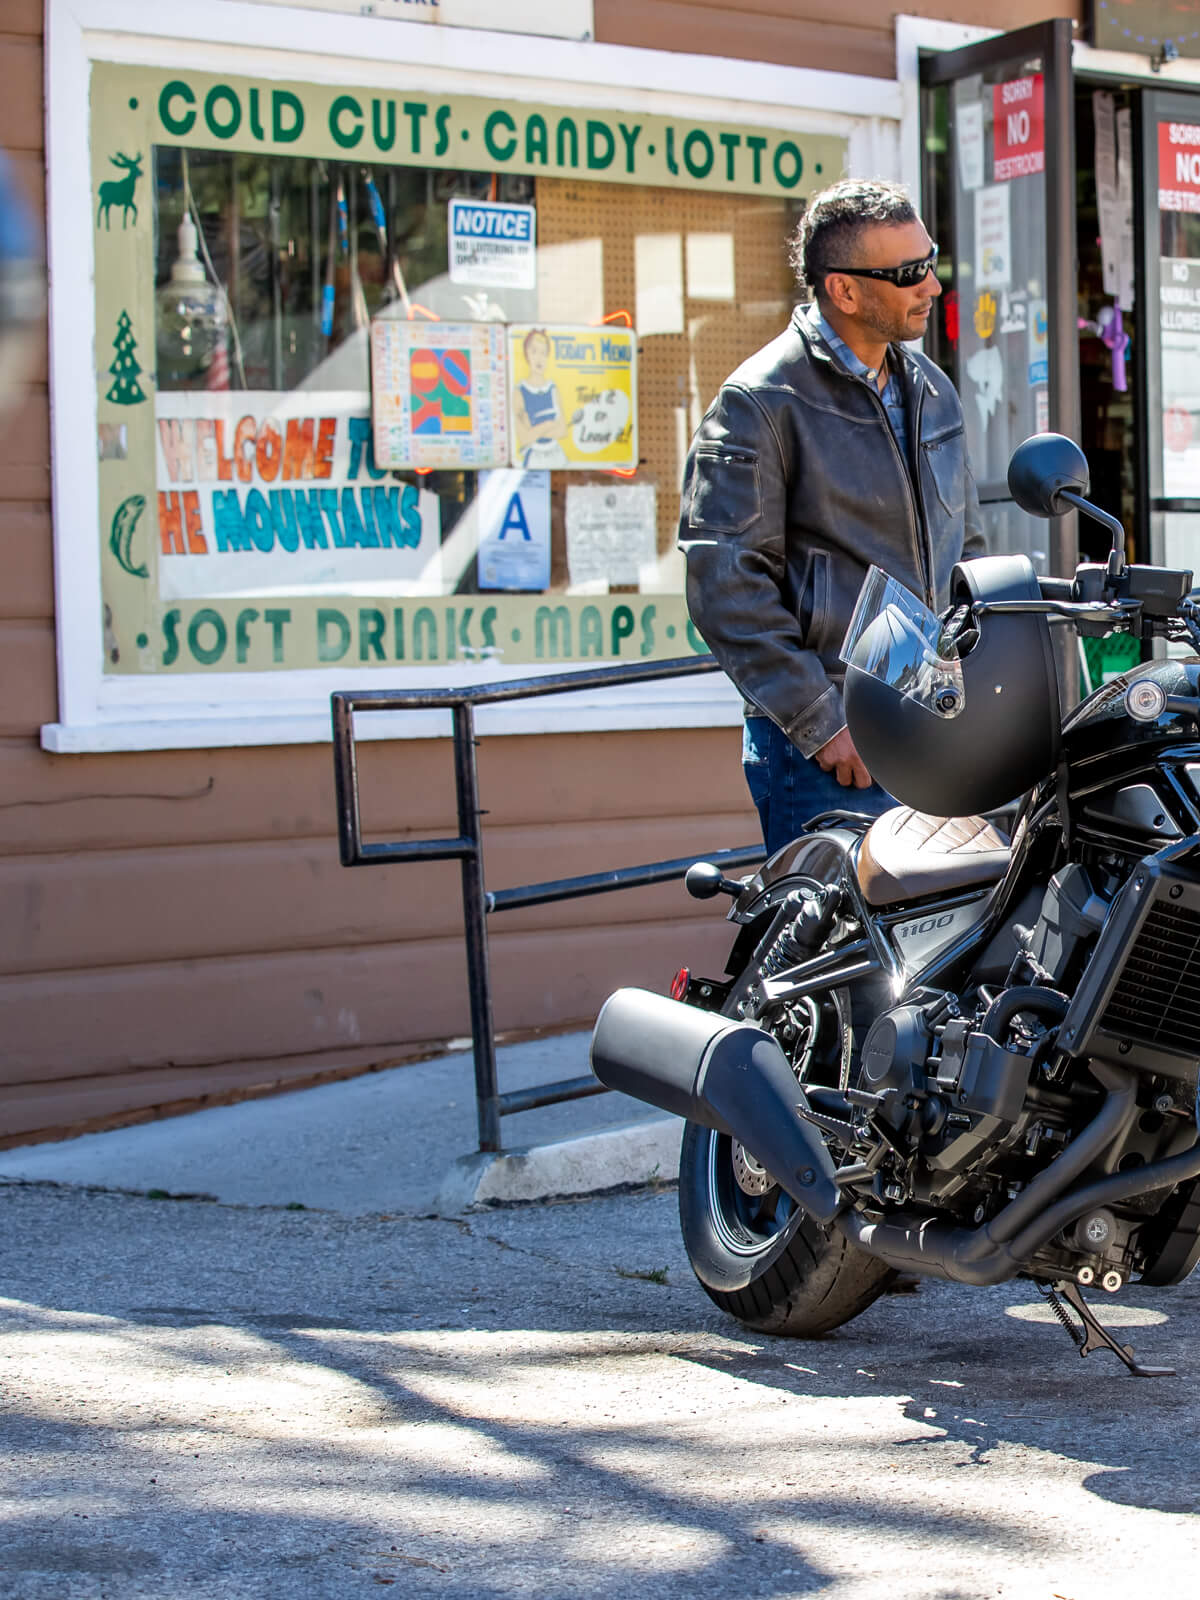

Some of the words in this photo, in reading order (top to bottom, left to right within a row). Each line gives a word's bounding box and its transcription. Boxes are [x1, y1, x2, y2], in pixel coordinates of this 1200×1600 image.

[1002, 79, 1034, 104] SORRY
[158, 80, 305, 143] COLD
[328, 95, 452, 157] CUTS
[484, 110, 642, 173] CANDY
[666, 126, 804, 189] LOTTO
[1007, 109, 1030, 146] NO
[456, 208, 529, 238] NOTICE
[158, 415, 337, 483] WELCOME
[157, 489, 209, 555] HE
[212, 485, 423, 552] MOUNTAINS
[498, 491, 532, 541] A
[162, 608, 292, 666] SOFT
[316, 605, 497, 663] DRINKS
[535, 604, 657, 658] MAPS
[900, 914, 954, 938] 1100
